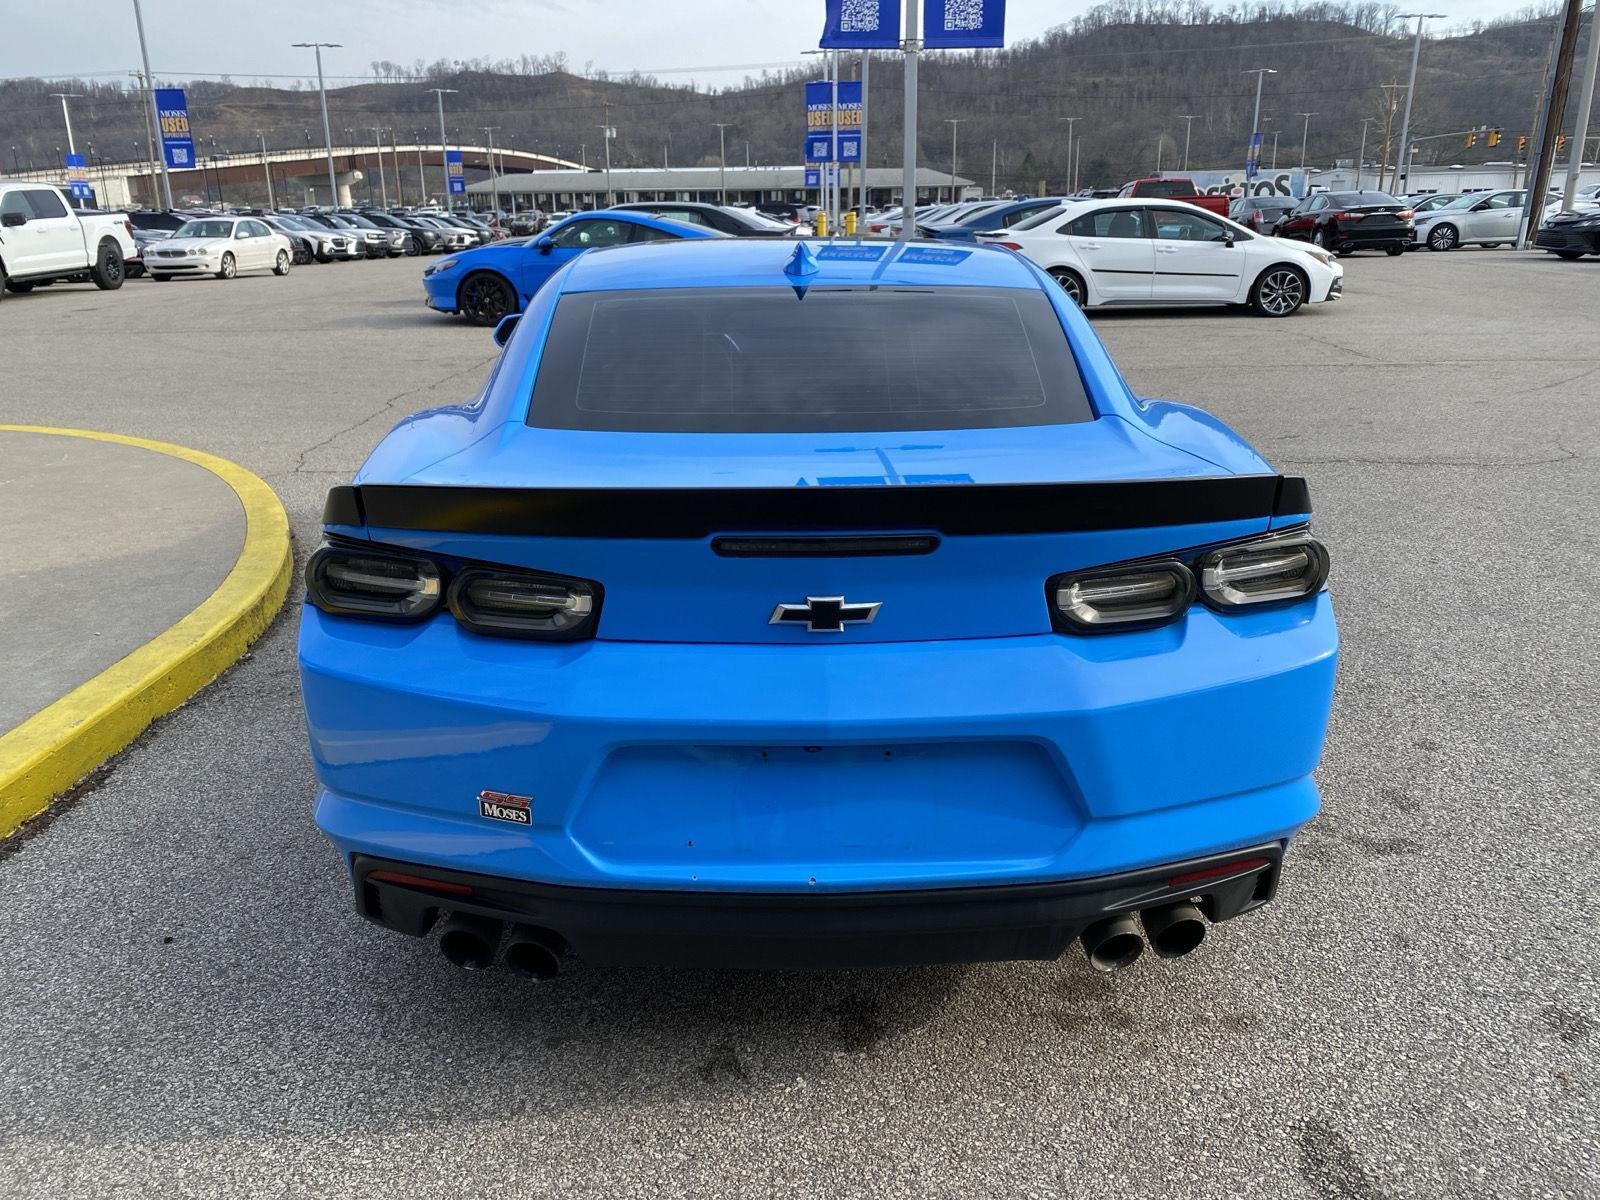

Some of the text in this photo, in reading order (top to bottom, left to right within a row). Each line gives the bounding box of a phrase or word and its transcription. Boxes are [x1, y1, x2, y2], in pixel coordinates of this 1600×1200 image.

[161, 117, 189, 132] USED
[808, 111, 833, 126] USED
[838, 110, 863, 125] USED
